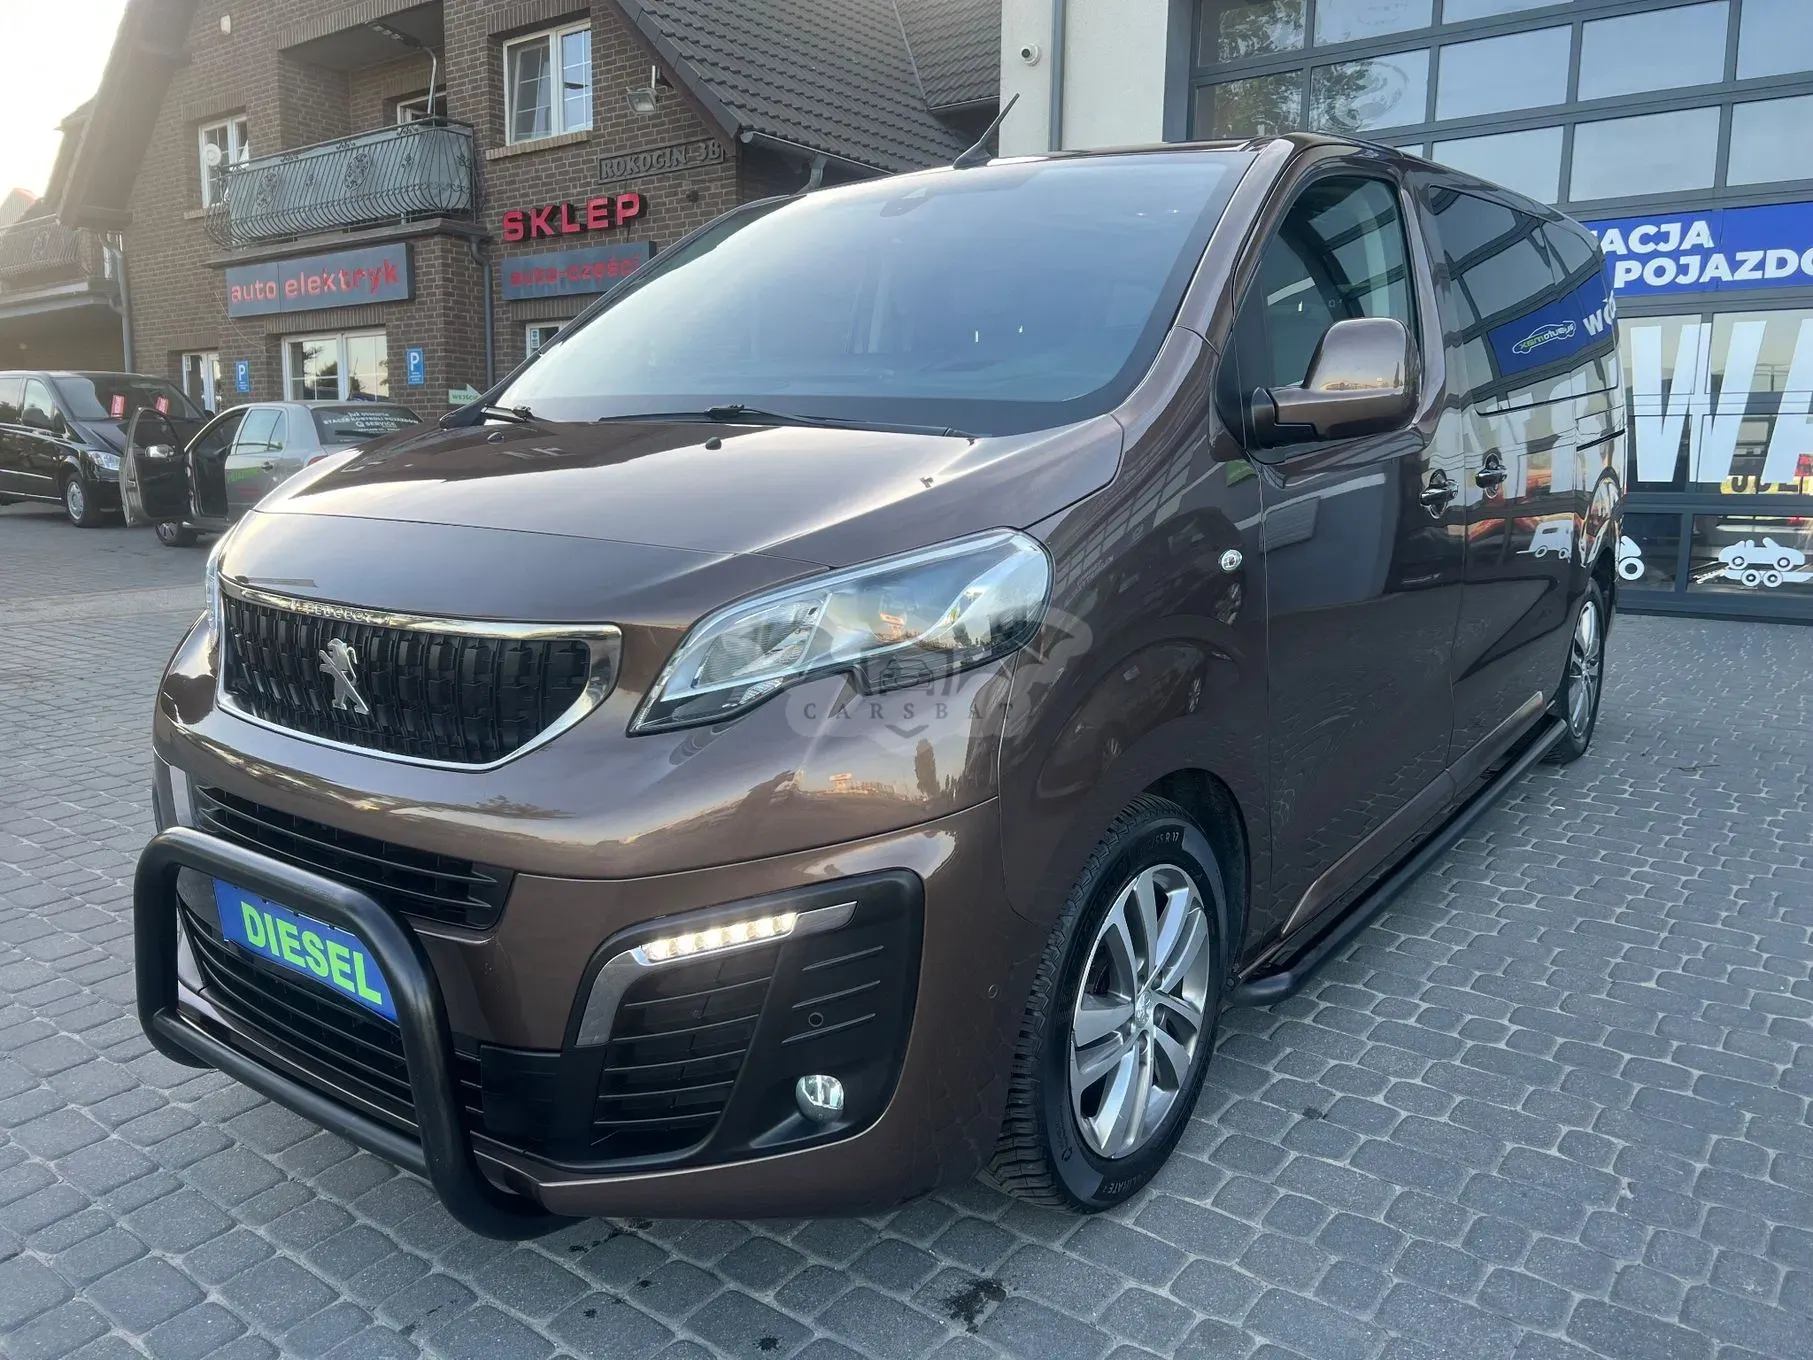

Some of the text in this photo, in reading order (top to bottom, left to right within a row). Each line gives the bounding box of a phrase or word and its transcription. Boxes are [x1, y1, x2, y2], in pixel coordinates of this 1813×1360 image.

[600, 146, 688, 180] ROKOCIN
[502, 192, 641, 242] SKLEP
[1592, 220, 1715, 256] ACJA
[231, 258, 399, 304] auto elektryk
[238, 364, 246, 381] P
[409, 351, 420, 372] P
[240, 901, 383, 1006] DIESEL
